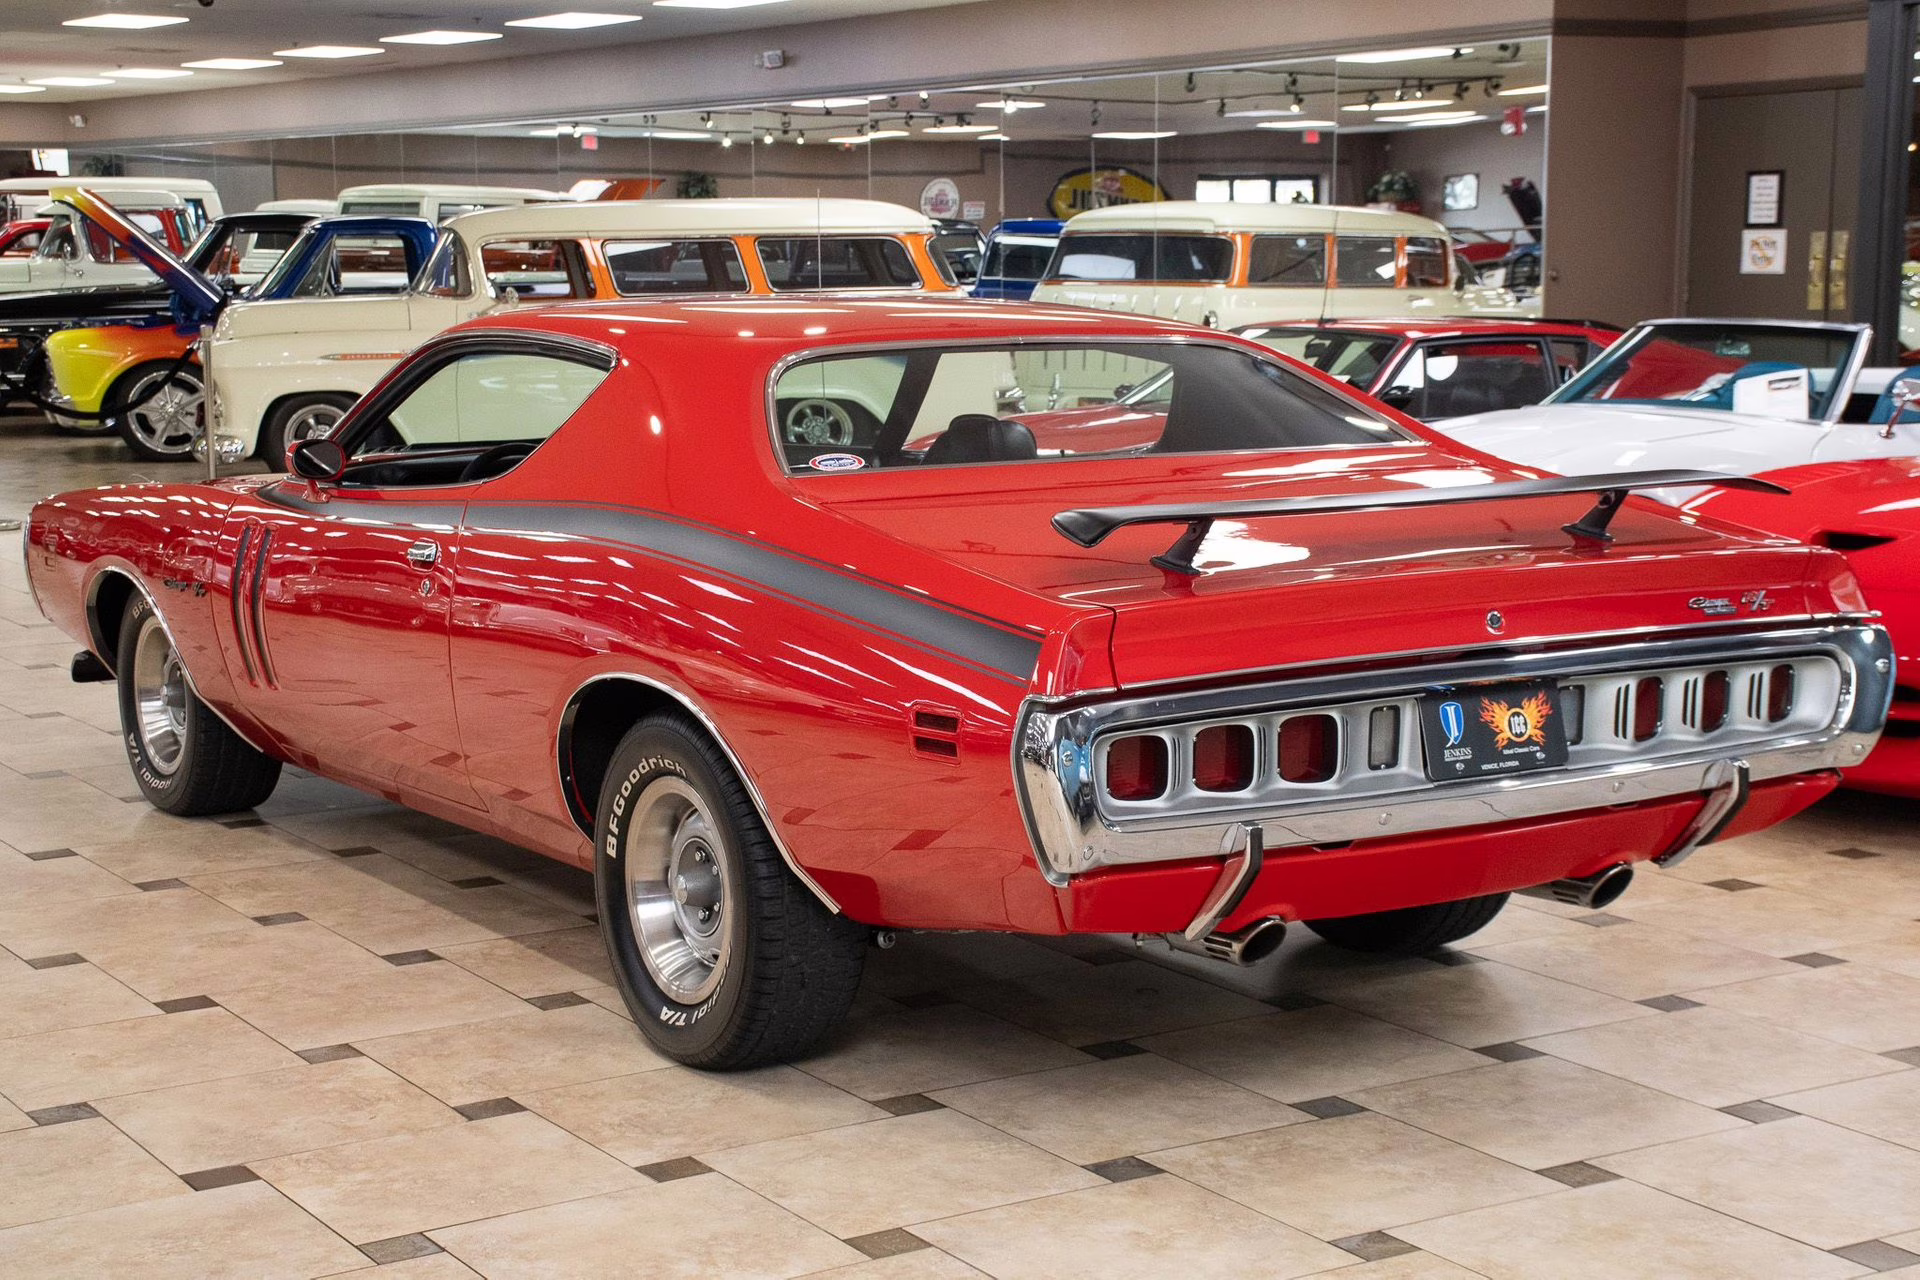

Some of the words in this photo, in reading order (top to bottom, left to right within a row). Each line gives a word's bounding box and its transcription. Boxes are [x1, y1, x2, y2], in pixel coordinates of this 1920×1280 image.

[1444, 747, 1472, 758] JENKINS
[606, 754, 687, 859] BFGoodrich
[660, 1005, 687, 1026] T/A
